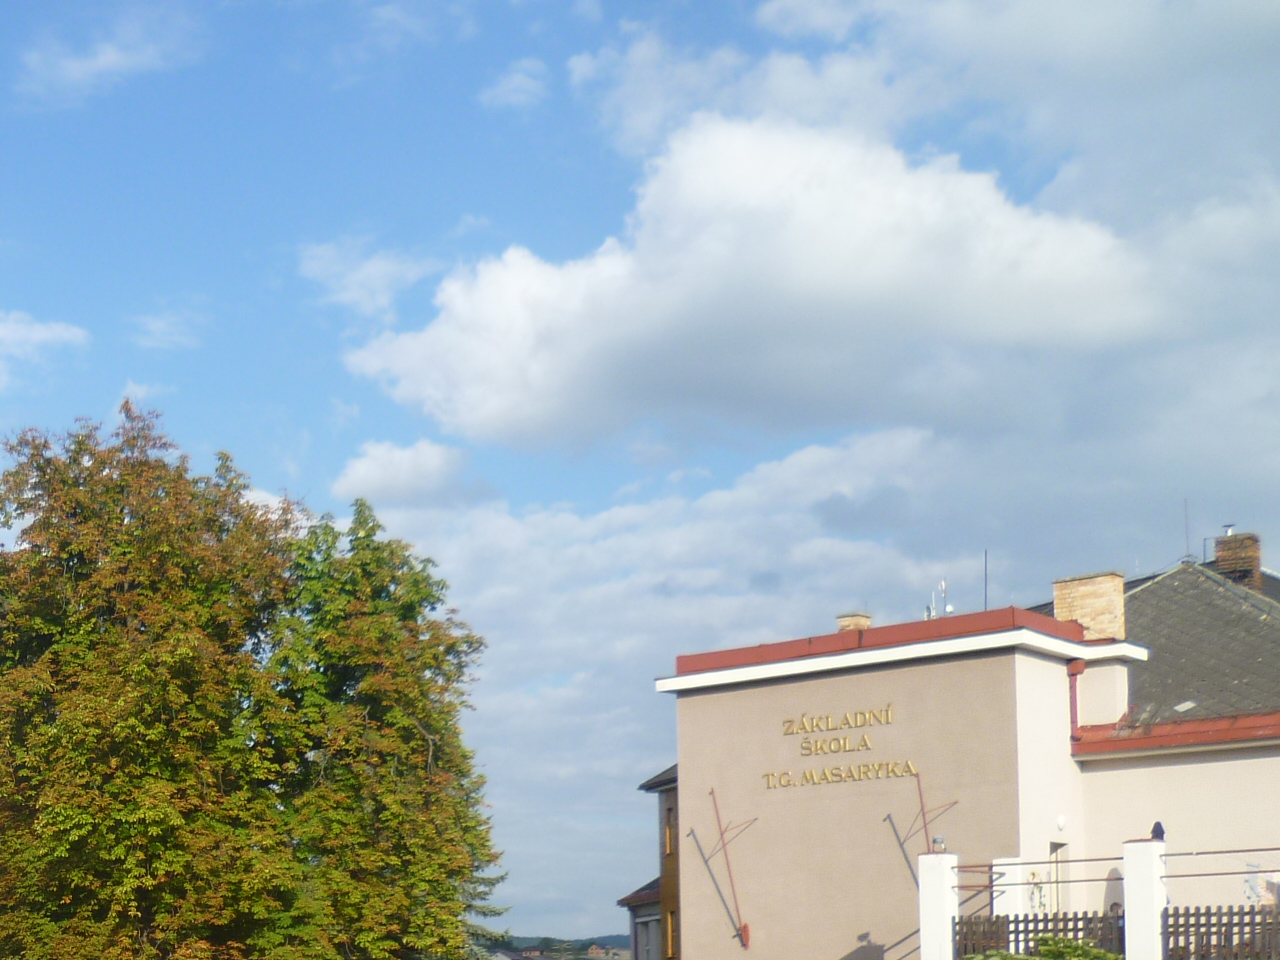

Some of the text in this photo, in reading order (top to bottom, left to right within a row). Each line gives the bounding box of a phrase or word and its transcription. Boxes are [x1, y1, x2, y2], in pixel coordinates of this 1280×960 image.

[782, 702, 893, 736] ZÁKLADNÍ
[800, 734, 872, 756] ŠKOLA
[800, 760, 919, 787] MASARYKA
